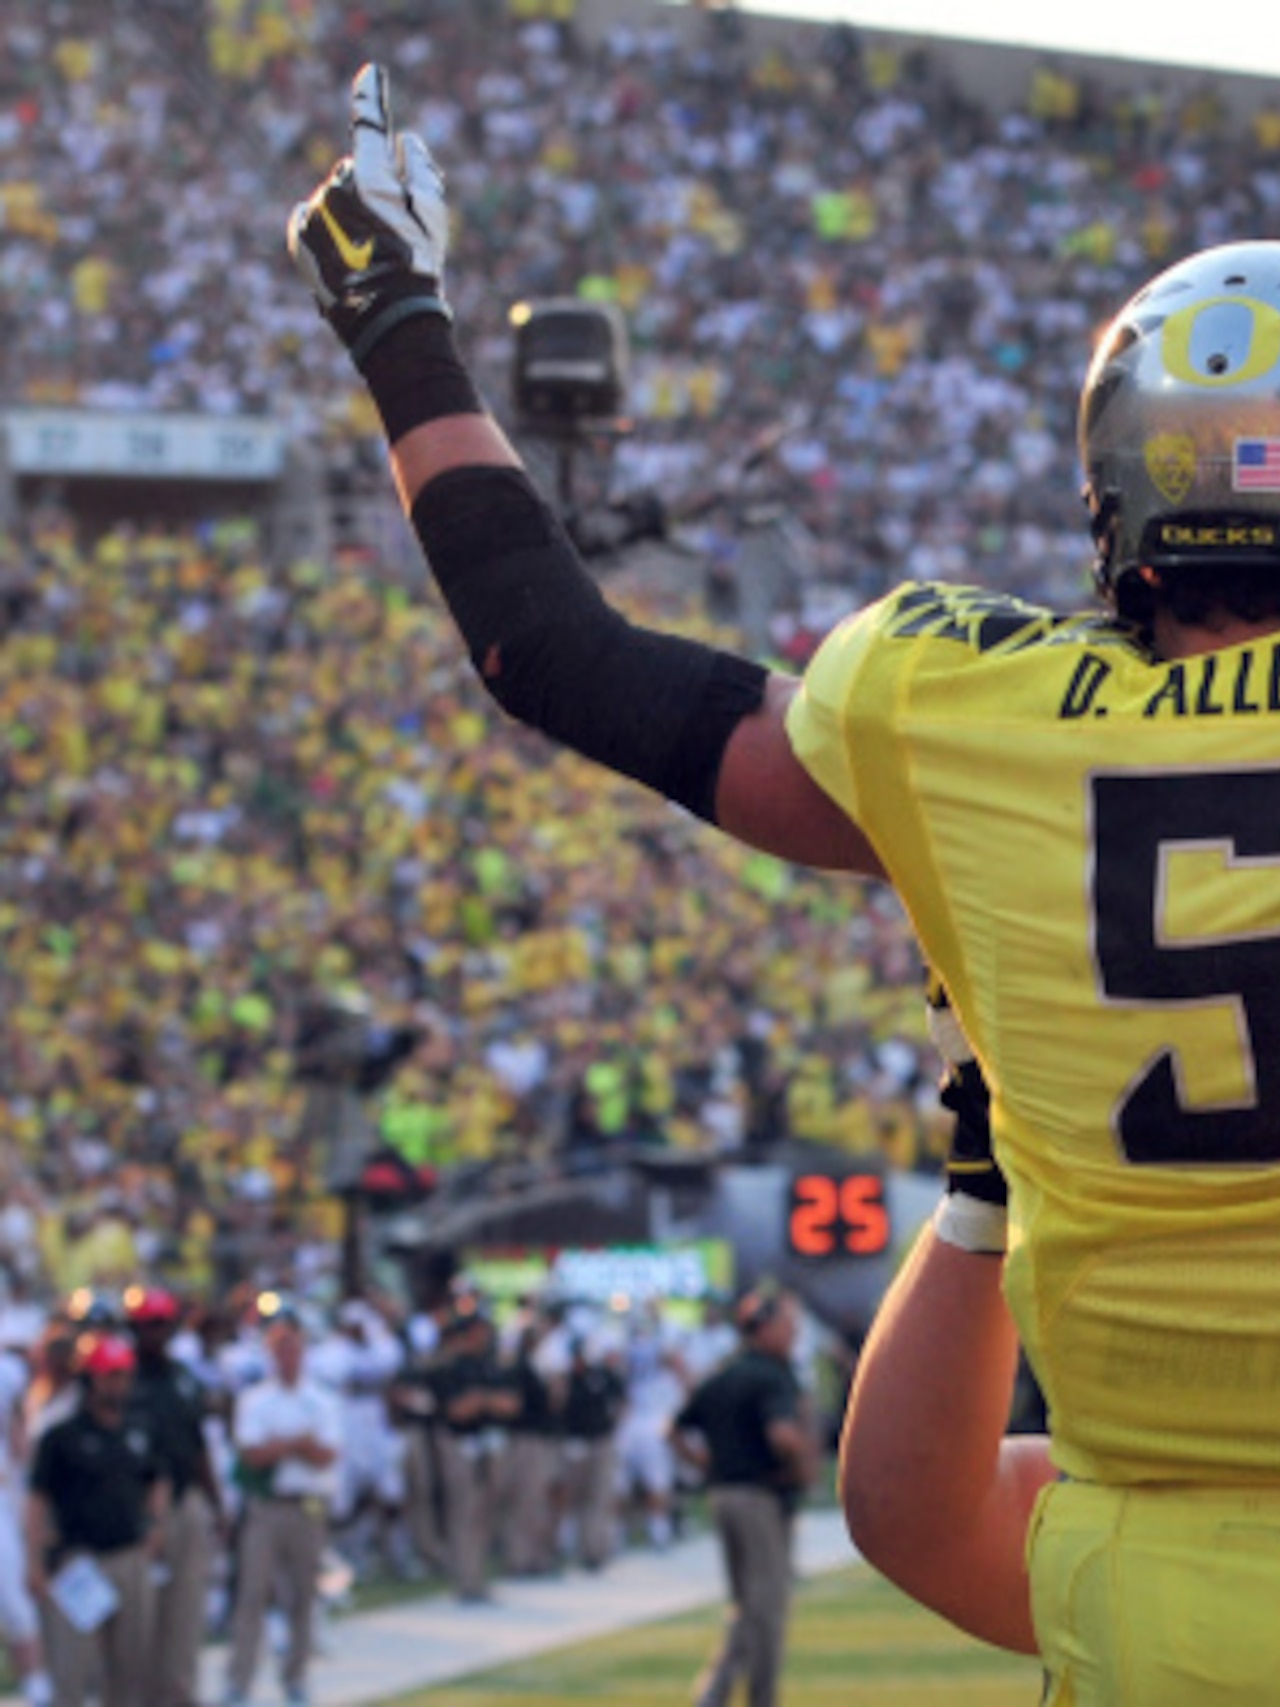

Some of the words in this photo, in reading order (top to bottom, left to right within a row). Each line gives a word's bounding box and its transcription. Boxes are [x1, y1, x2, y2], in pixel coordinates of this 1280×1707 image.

[1161, 524, 1274, 545] DUCKS
[1058, 652, 1111, 720] D.
[790, 1175, 890, 1255] 25
